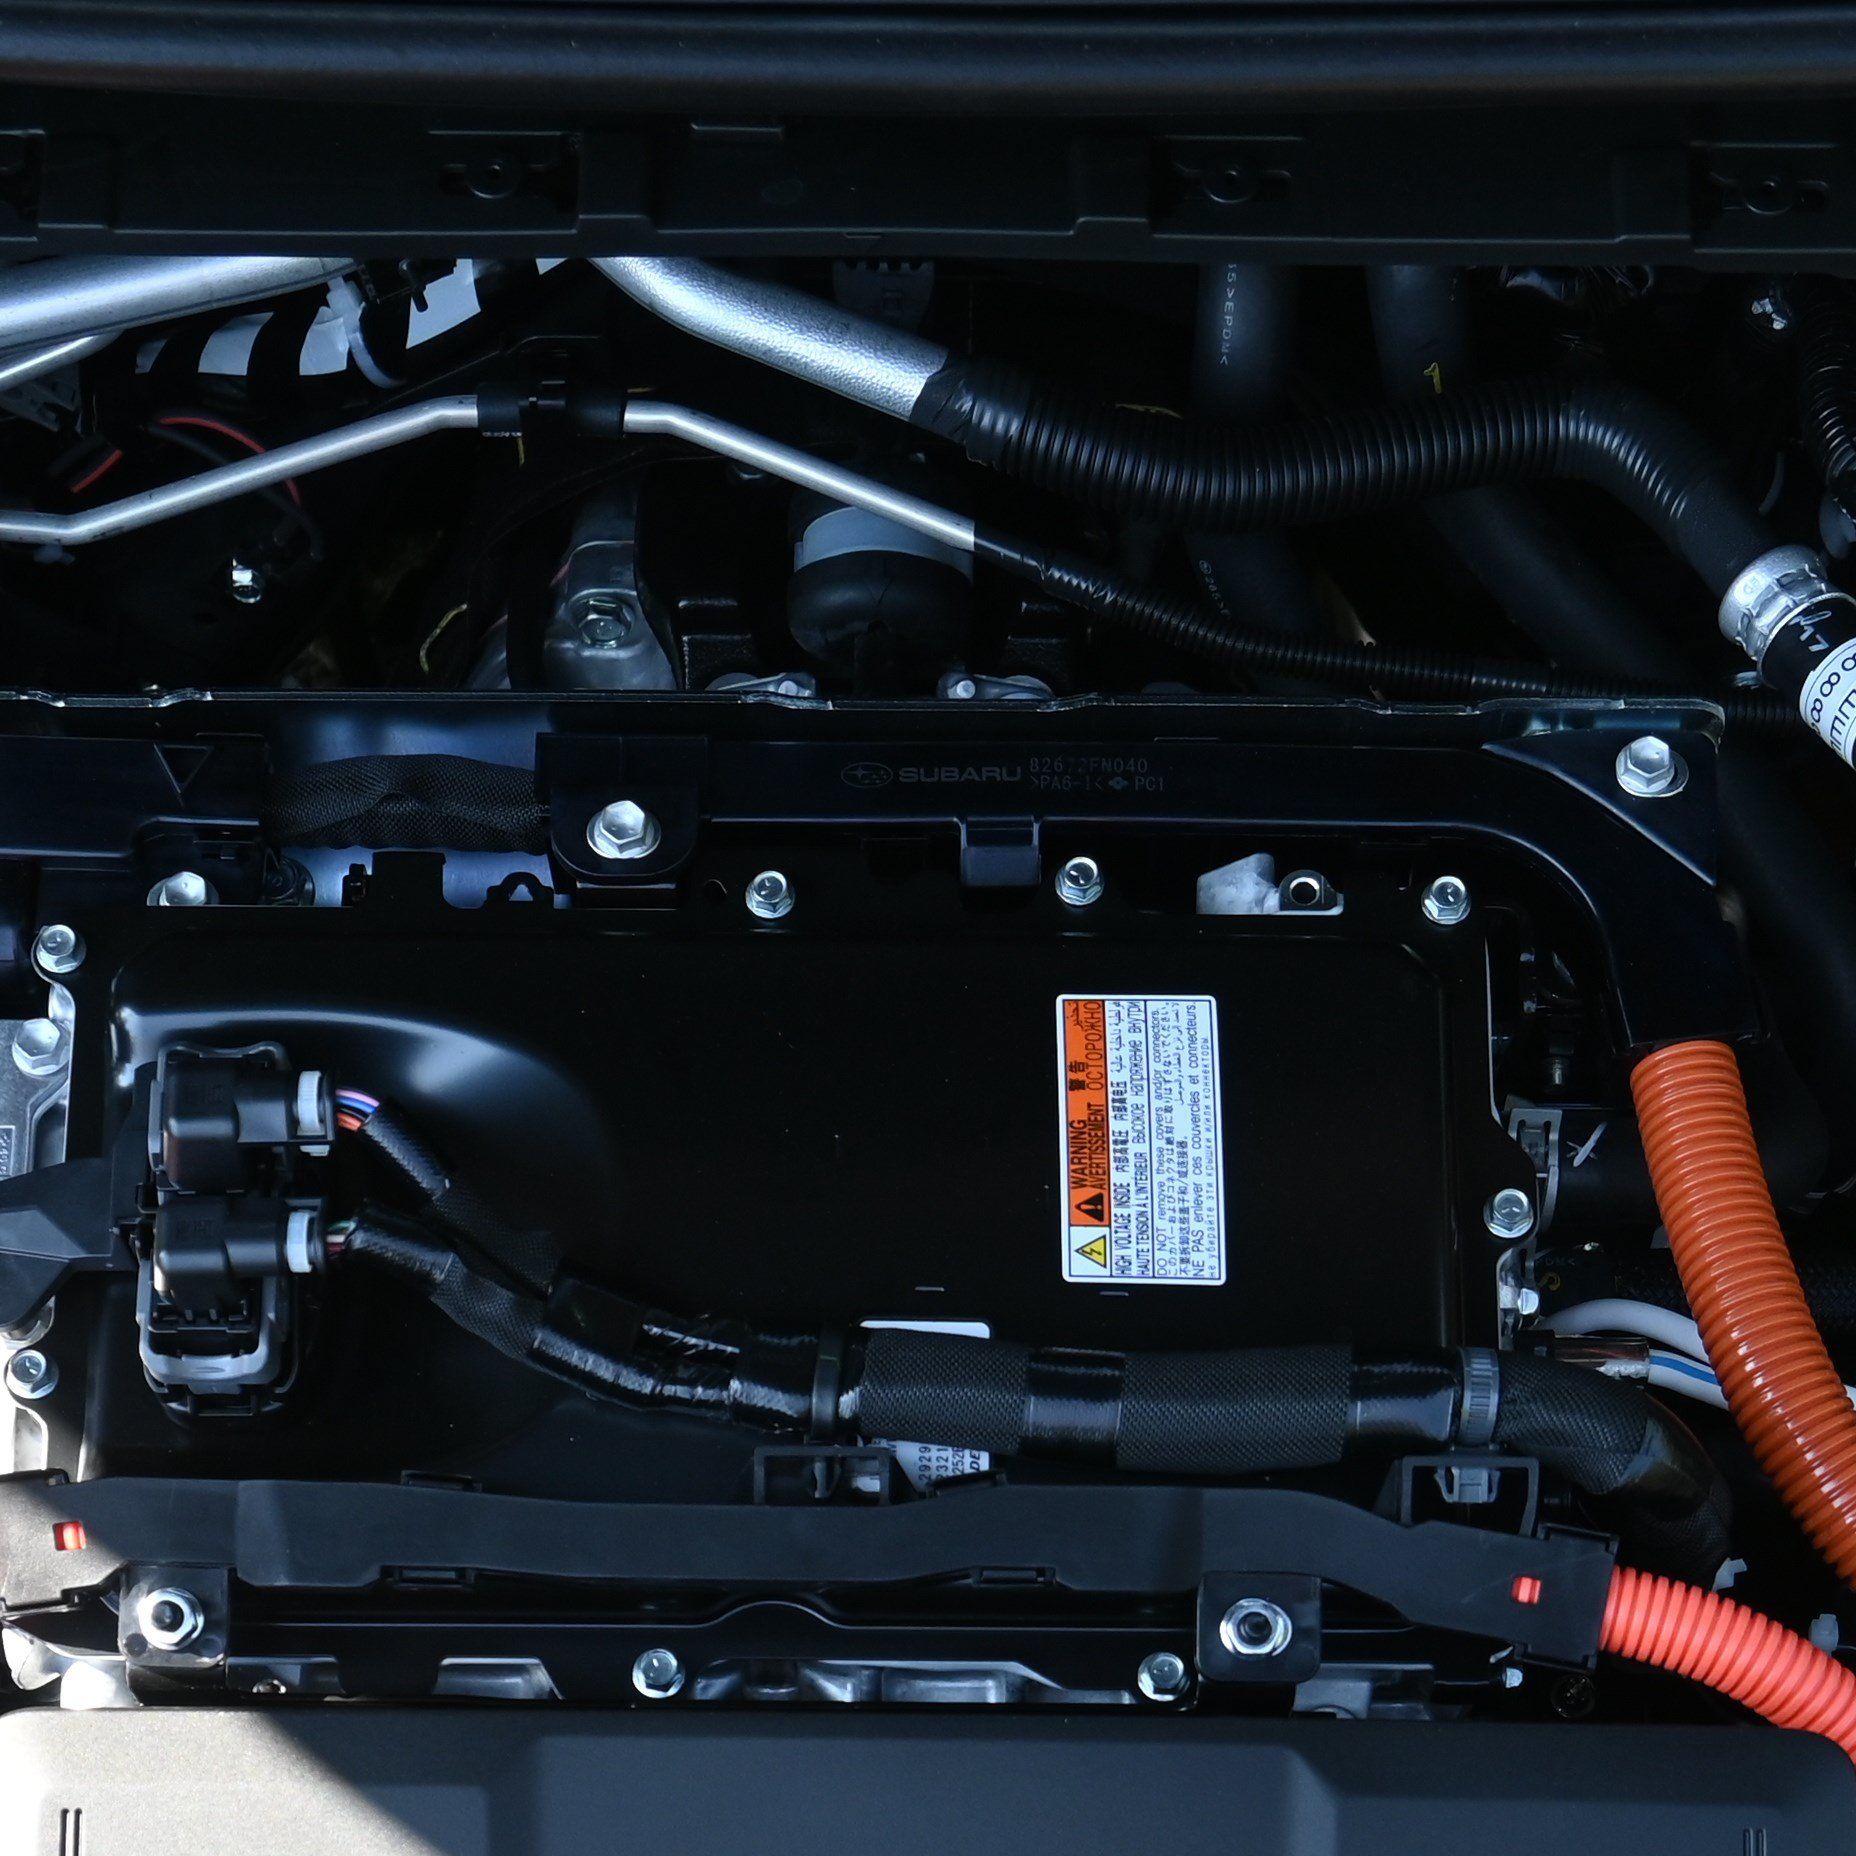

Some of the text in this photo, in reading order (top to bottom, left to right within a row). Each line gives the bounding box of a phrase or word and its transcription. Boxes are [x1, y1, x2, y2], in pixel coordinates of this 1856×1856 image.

[898, 766, 1021, 783] SUBARU
[1067, 1060, 1086, 1091] 警告
[1083, 1001, 1104, 1090] ОСТОРОЖНО
[1069, 1118, 1088, 1189] WARNING
[1086, 1101, 1106, 1189] AVERTISSEMENT
[1149, 1009, 1168, 1276] DO NOT remove these covers and/or connectors.
[1185, 1001, 1204, 1276] NE PAS enlever ces couvercles et connecteurs.
[1113, 1182, 1132, 1274] HIGH VOLTAGE INSIDE
[1135, 1209, 1149, 1244] TENSION
[1136, 1248, 1150, 1274] HAUTE
[970, 1450, 981, 1471] DE
